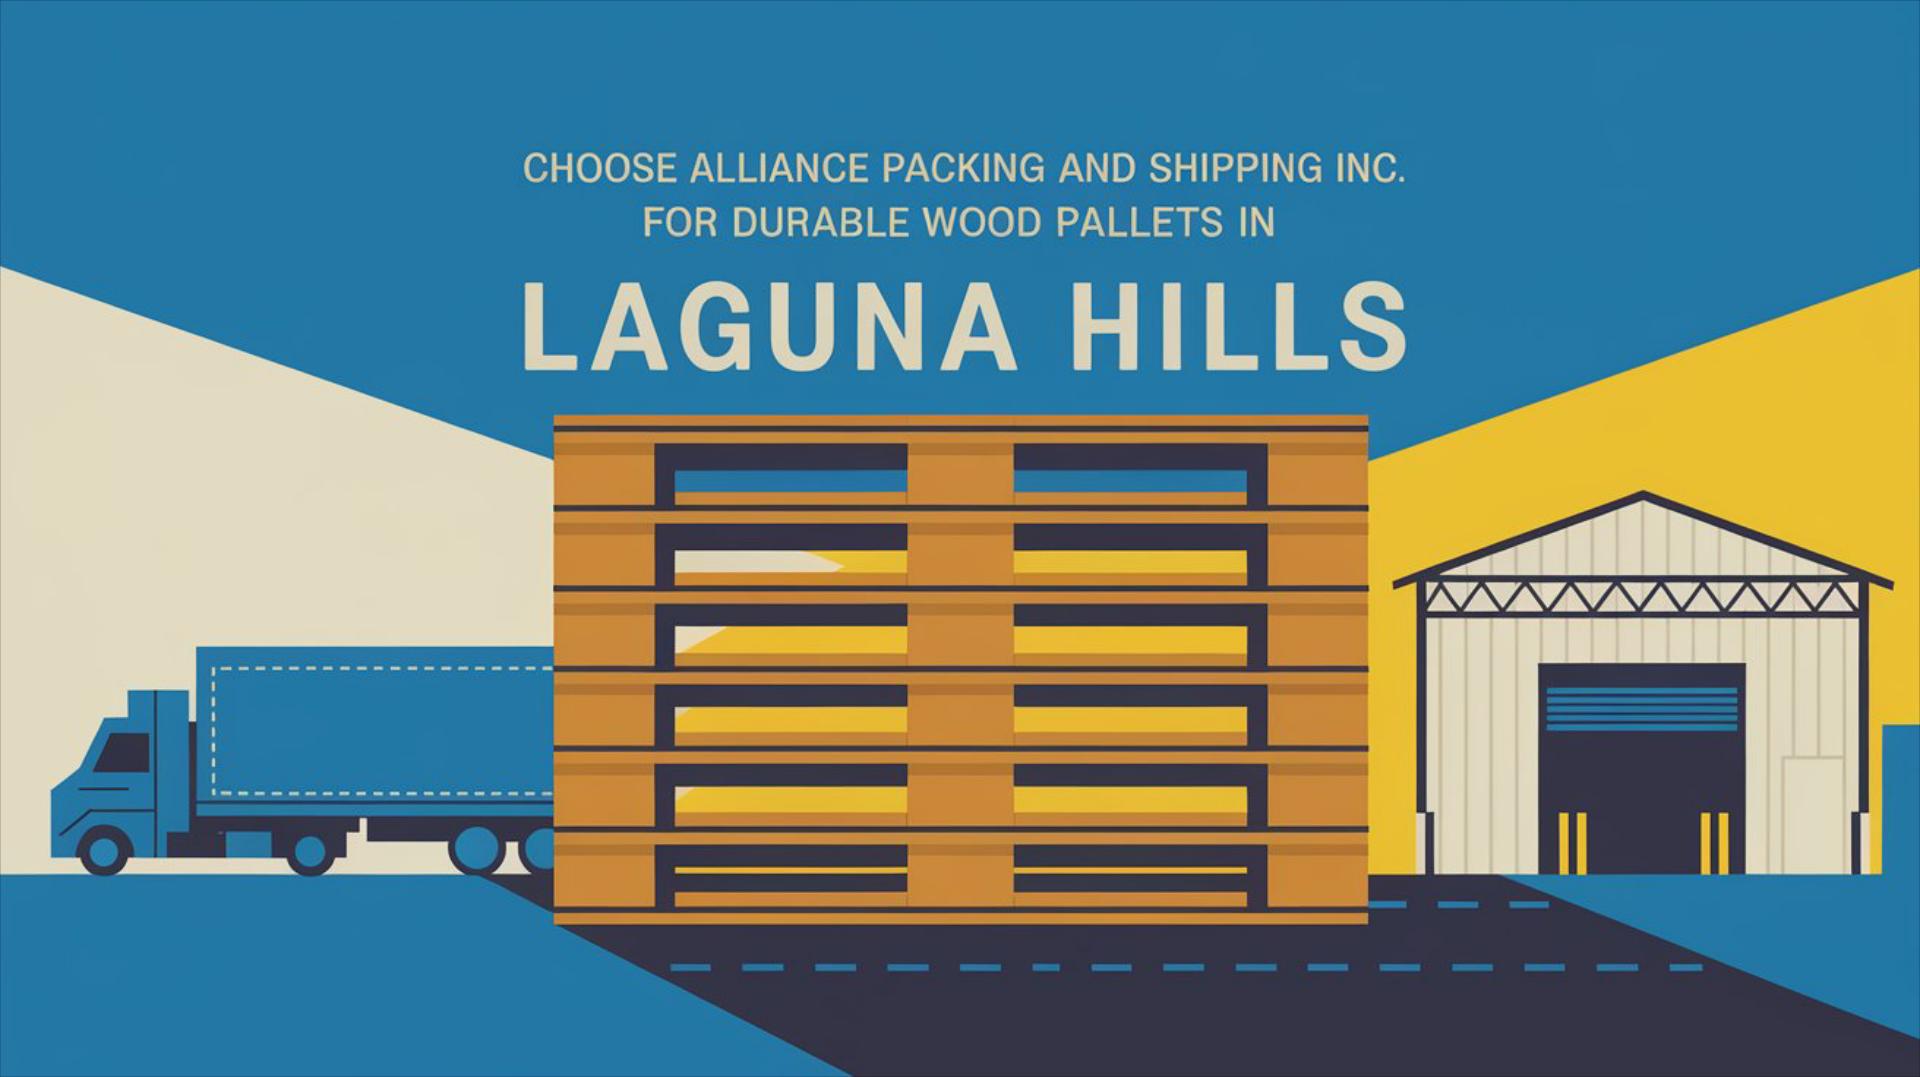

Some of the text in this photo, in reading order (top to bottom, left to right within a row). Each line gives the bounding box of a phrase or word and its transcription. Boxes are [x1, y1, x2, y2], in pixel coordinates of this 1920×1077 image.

[523, 151, 1405, 184] CHOOSE ALLIANCE PACKING AND SHIPPING INC.
[644, 206, 1275, 238] FOR DURABLE WOOD PALLETS IN
[524, 280, 1407, 372] LAGUNA HILLS
